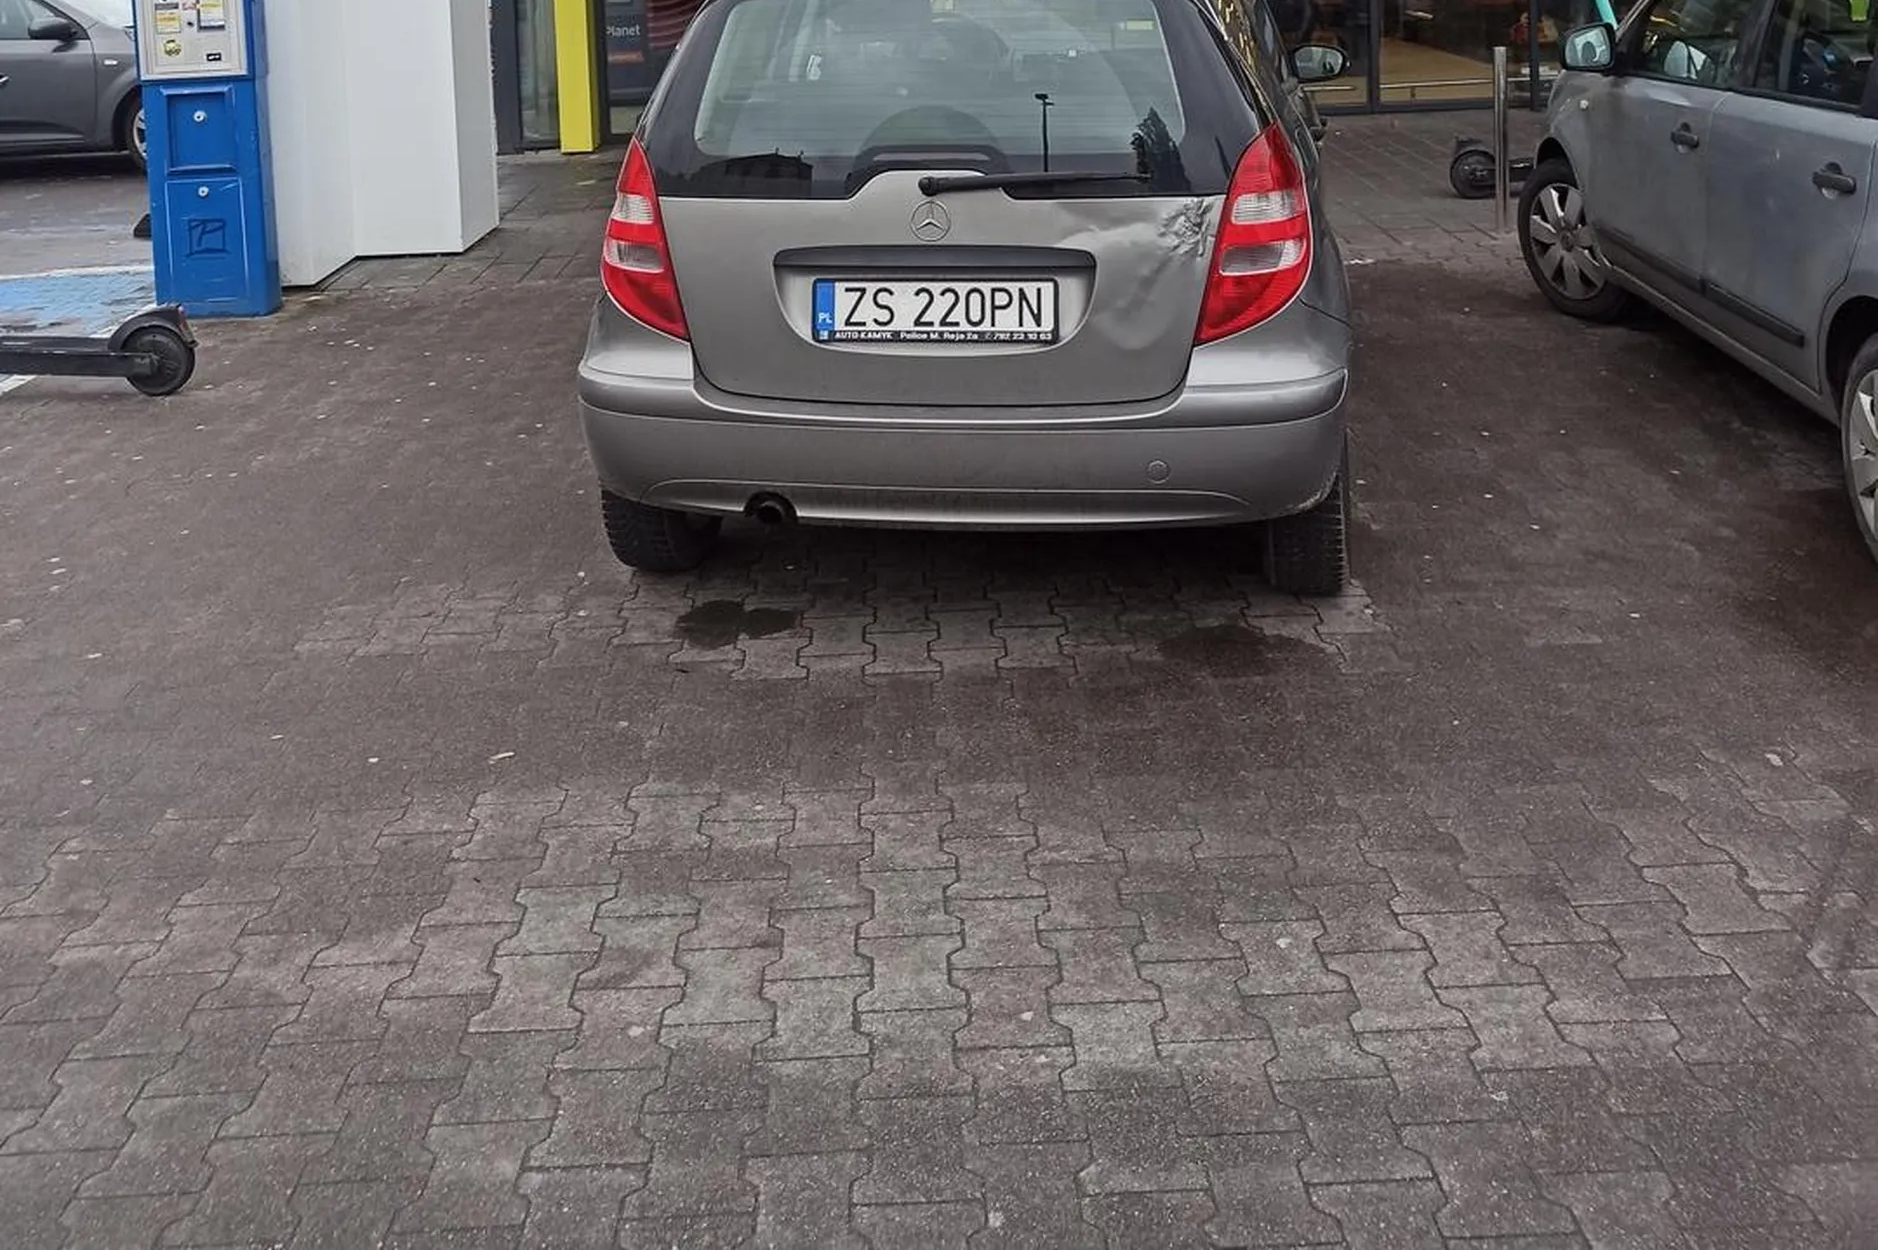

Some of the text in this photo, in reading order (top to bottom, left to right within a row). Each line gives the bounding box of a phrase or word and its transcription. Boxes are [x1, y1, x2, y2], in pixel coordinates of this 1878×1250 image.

[844, 287, 1043, 328] ZS 220PN
[818, 312, 833, 324] PL
[834, 331, 858, 339] AUTO
[860, 331, 893, 339] KAMYK
